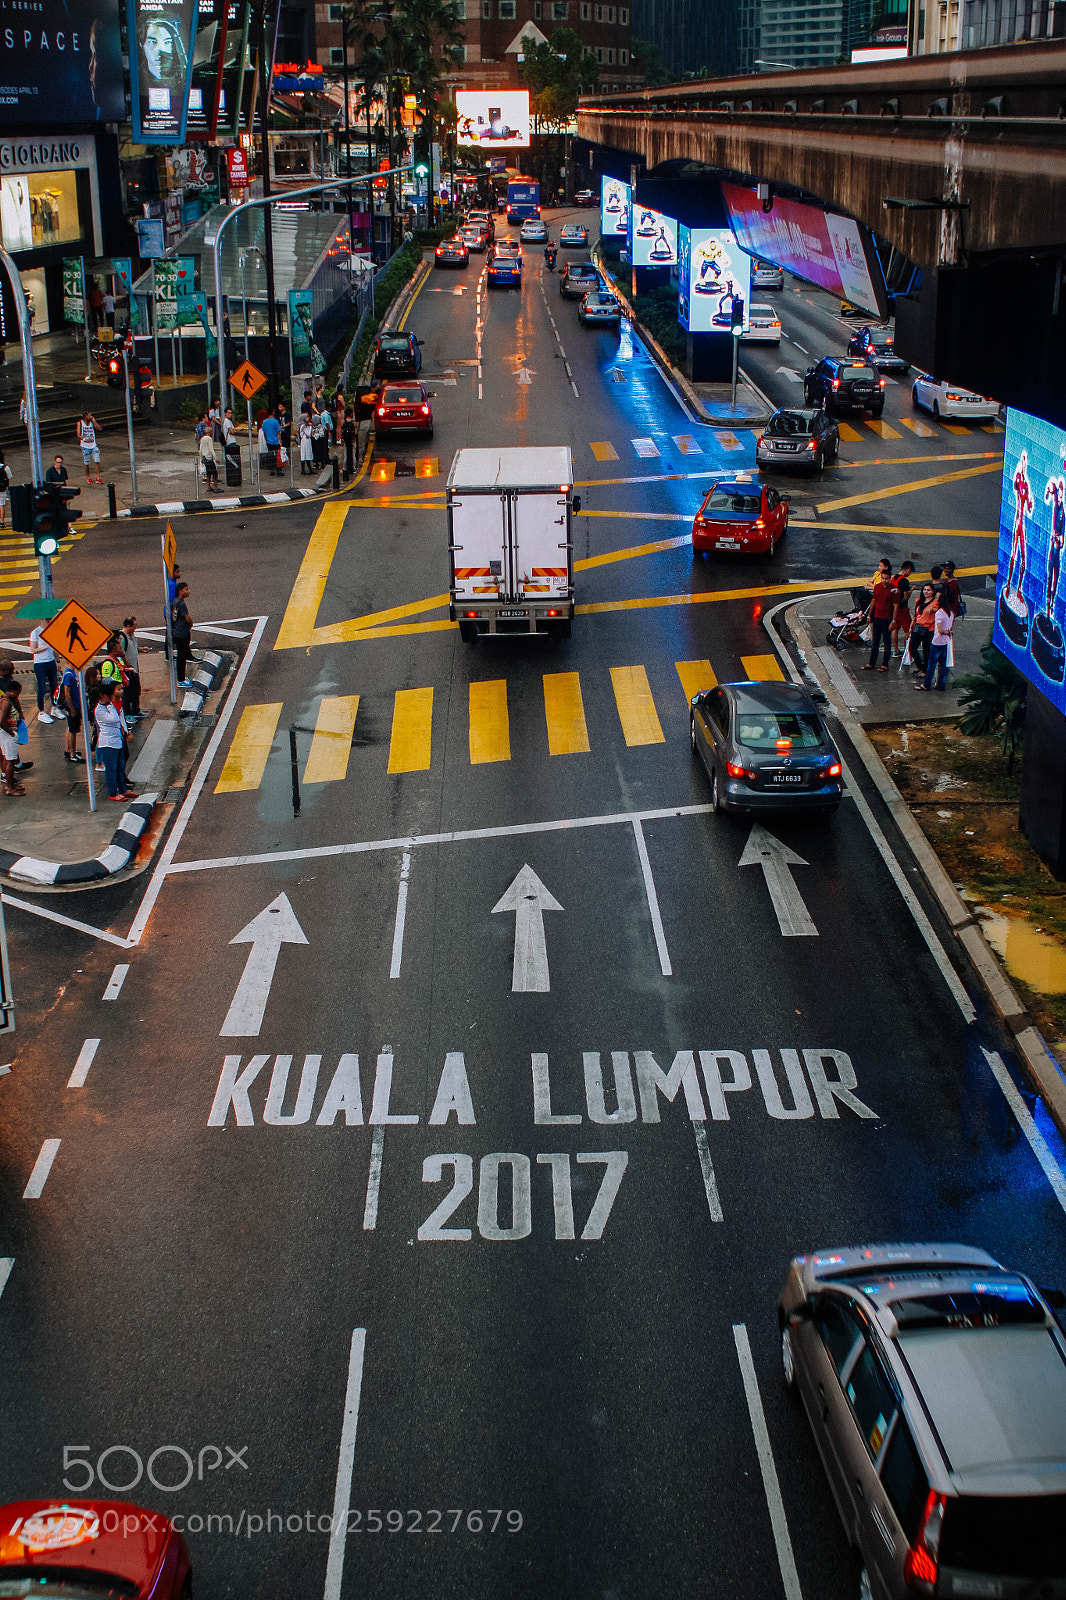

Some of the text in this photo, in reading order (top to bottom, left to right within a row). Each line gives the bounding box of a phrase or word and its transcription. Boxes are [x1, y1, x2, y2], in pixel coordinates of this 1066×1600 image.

[12, 1, 43, 11] SERIES
[5, 28, 80, 51] SPACE
[0, 143, 81, 168] GIORDANO
[64, 280, 83, 297] KL
[155, 284, 177, 300] KL
[207, 1047, 880, 1127] KUALA LUMPUR
[416, 1150, 629, 1242] 2017
